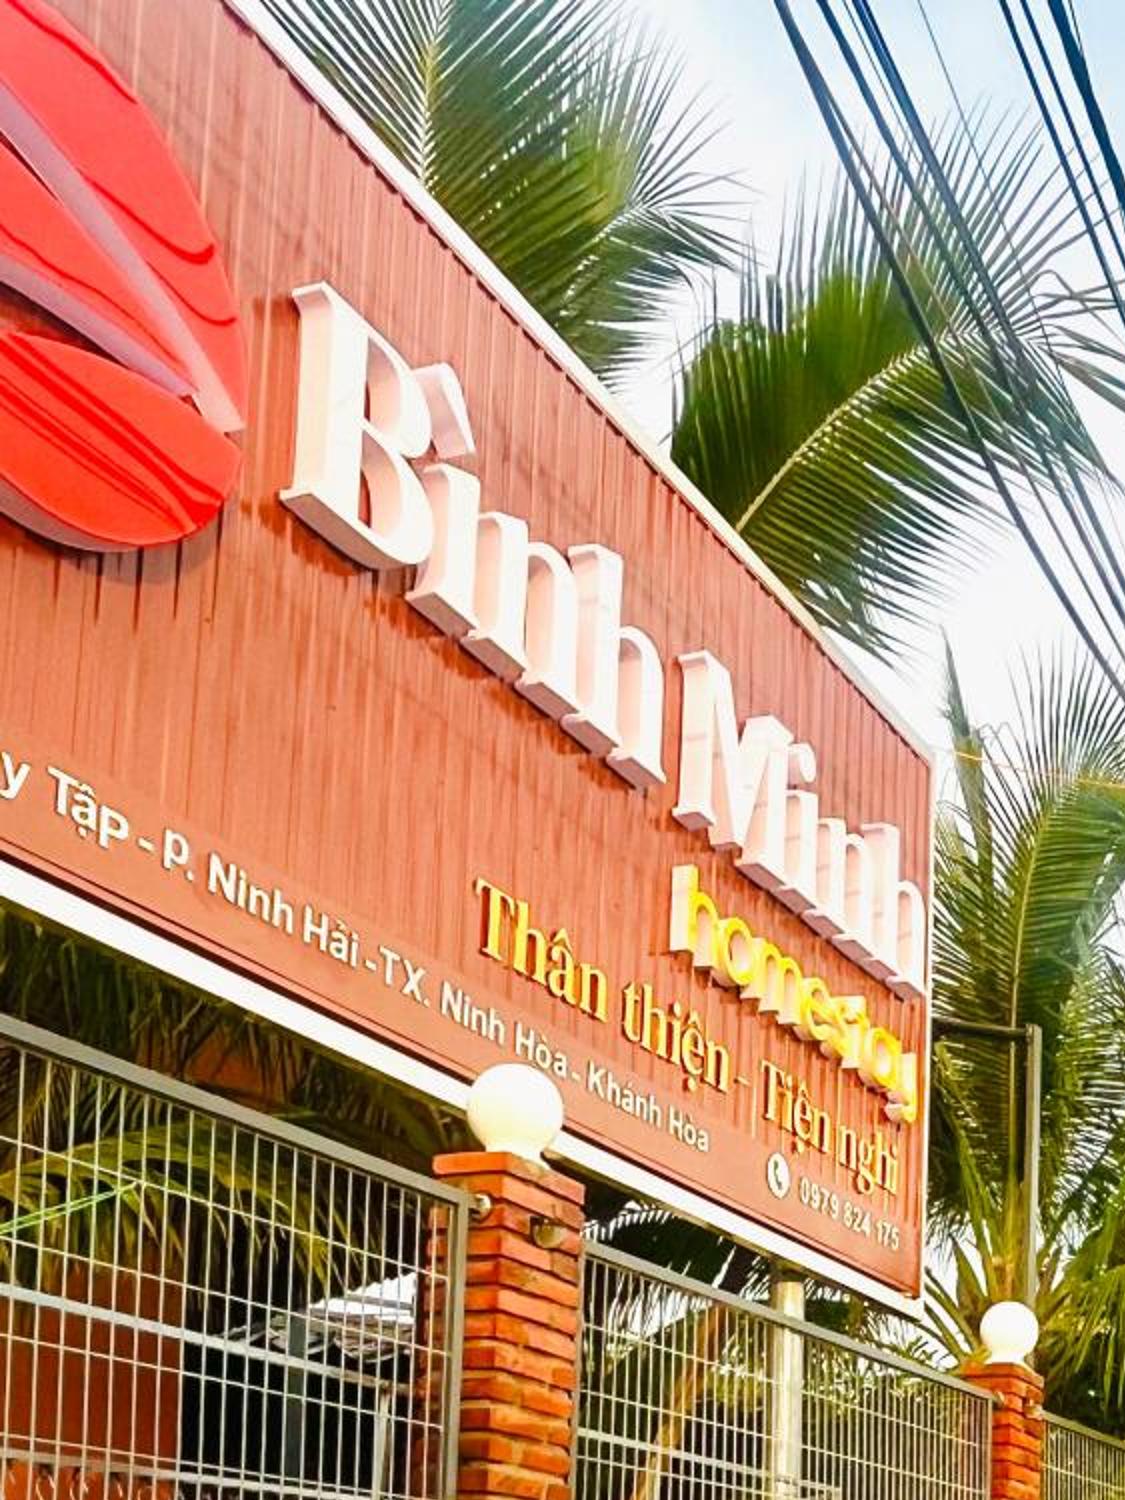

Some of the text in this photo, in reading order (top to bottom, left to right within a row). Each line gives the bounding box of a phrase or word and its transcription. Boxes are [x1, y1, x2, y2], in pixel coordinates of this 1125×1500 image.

[279, 280, 928, 1002] Bình Minh
[47, 766, 129, 849] Tập
[208, 853, 293, 934] Ninh
[303, 904, 359, 967] Hải
[441, 981, 505, 1044] Ninh
[515, 1021, 567, 1074] Hòa
[588, 1061, 662, 1126] Khánh
[668, 1110, 710, 1152] Hòa
[474, 877, 607, 1022] Thân
[622, 981, 729, 1094] thiện
[761, 1060, 830, 1153] Tiện
[839, 1125, 897, 1195] nghi
[670, 864, 917, 1124] homestay
[801, 1178, 900, 1250] 0979 824 175
